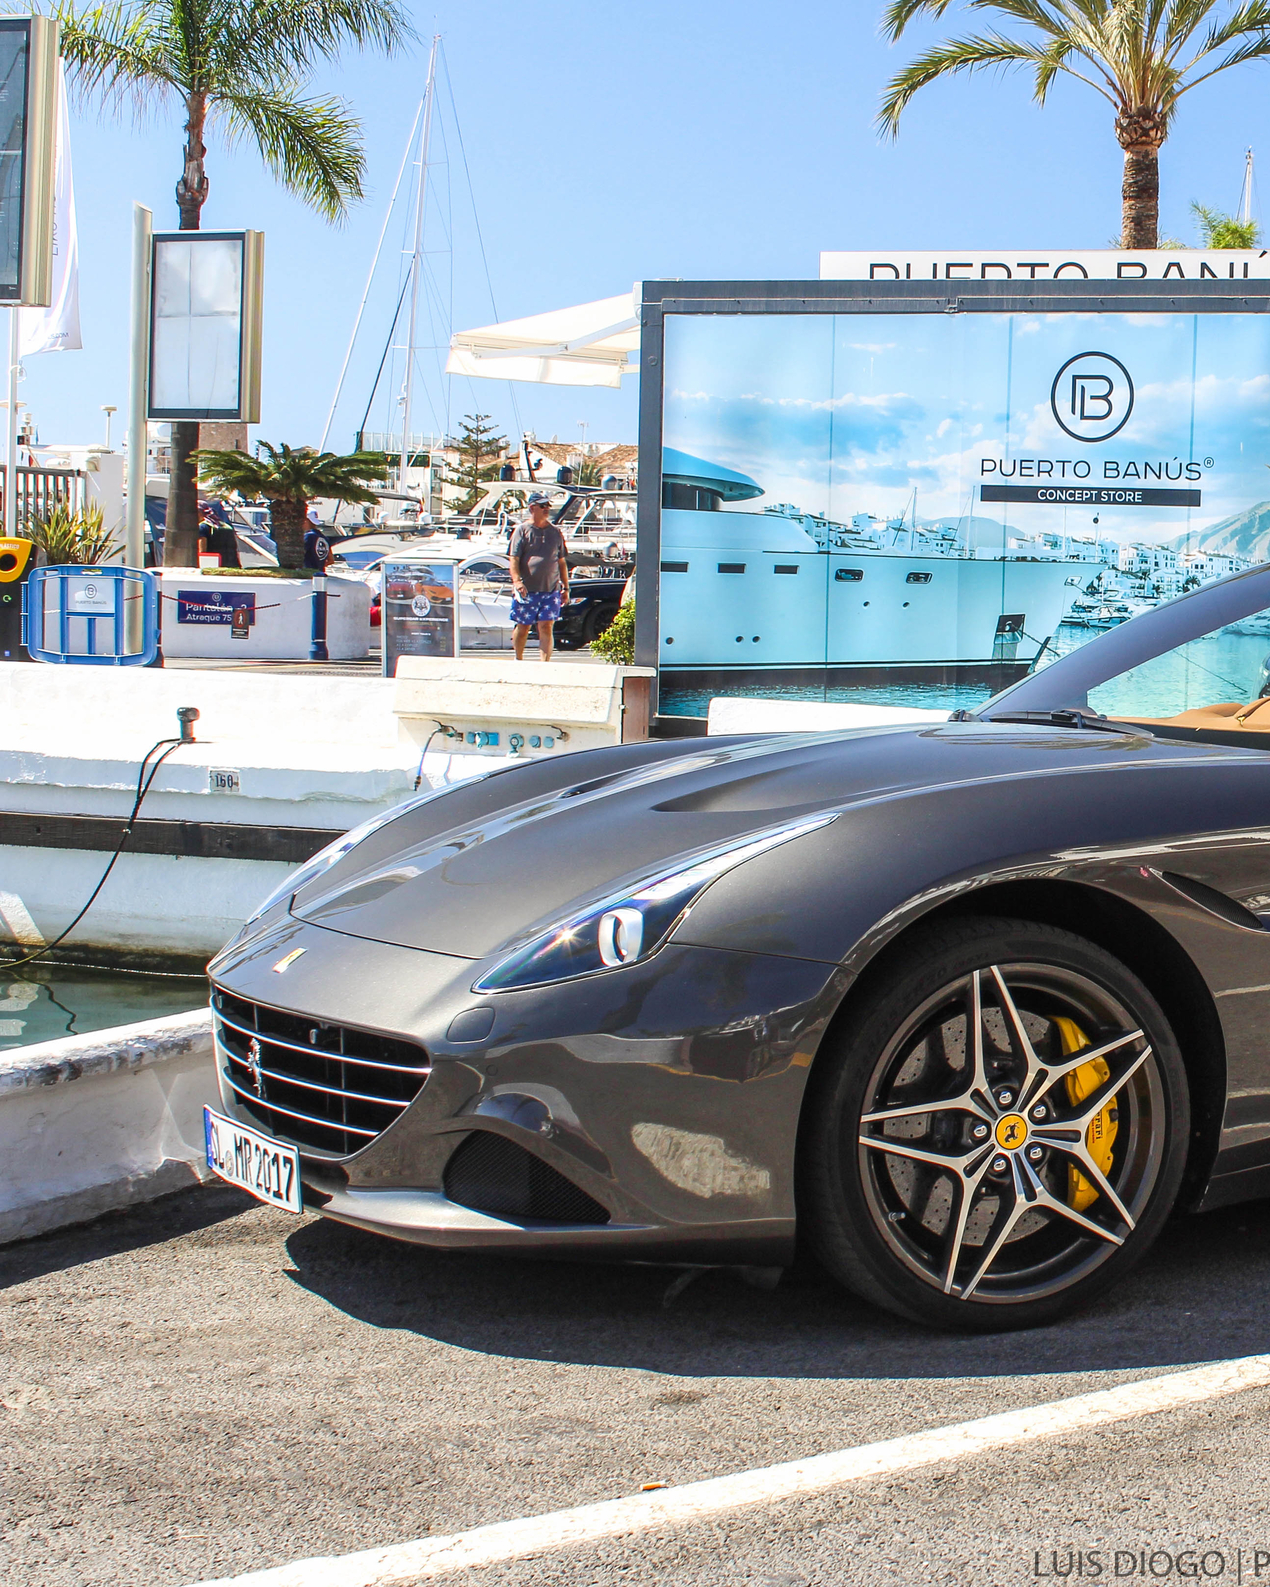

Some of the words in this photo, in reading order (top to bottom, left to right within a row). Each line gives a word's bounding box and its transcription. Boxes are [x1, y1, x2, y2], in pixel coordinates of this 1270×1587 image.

[980, 458, 1091, 479] PUERTO
[1037, 489, 1098, 503] CONCEPT
[1100, 490, 1143, 503] STORE
[185, 613, 221, 622] Atraque
[254, 1143, 294, 1204] 2017
